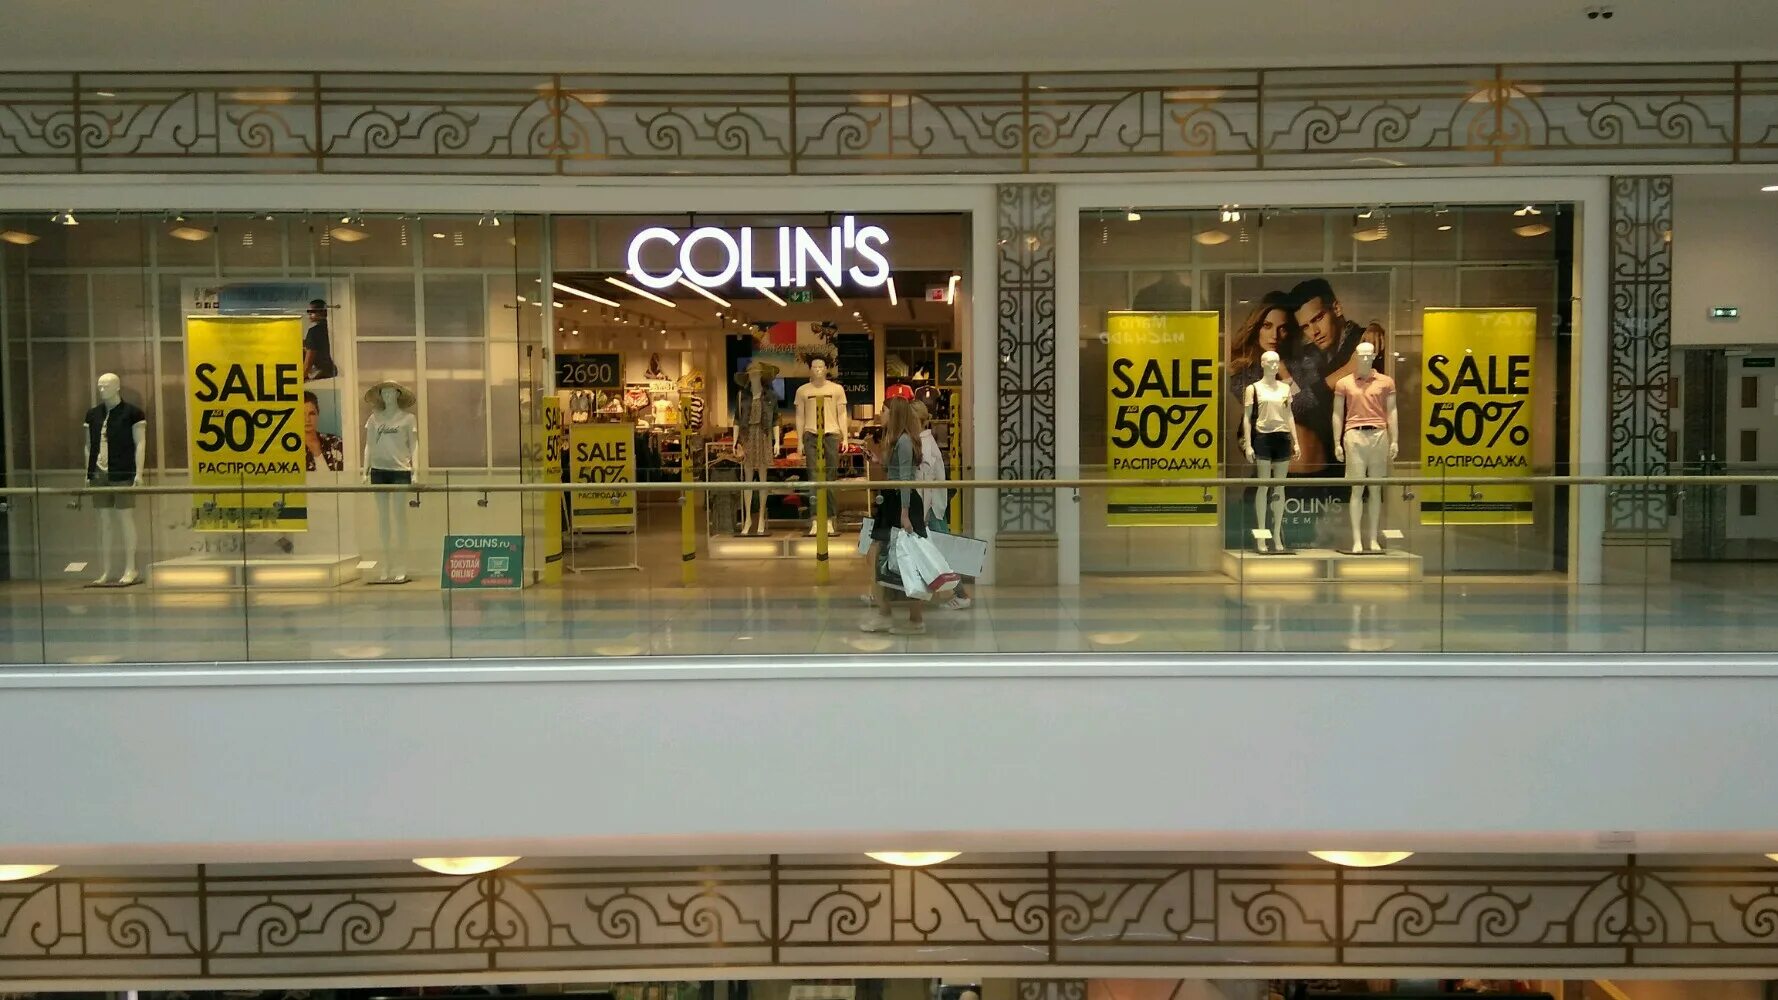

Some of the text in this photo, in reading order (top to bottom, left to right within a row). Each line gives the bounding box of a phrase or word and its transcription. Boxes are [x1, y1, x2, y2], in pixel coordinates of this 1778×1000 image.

[628, 216, 890, 289] COLIN'S
[195, 363, 299, 402] SALE
[1111, 358, 1213, 398] SALE
[1426, 355, 1530, 395] SALE
[196, 408, 302, 454] 50%
[1112, 404, 1213, 450] 50%
[1426, 401, 1529, 448] 50%
[199, 462, 300, 475] РАСПРОДАЖА
[577, 442, 626, 462] SALE
[1113, 458, 1211, 471] РАСПРОДАЖА
[1427, 455, 1528, 468] РАСПРОДАЖА
[455, 538, 510, 548] COLINS.ru
